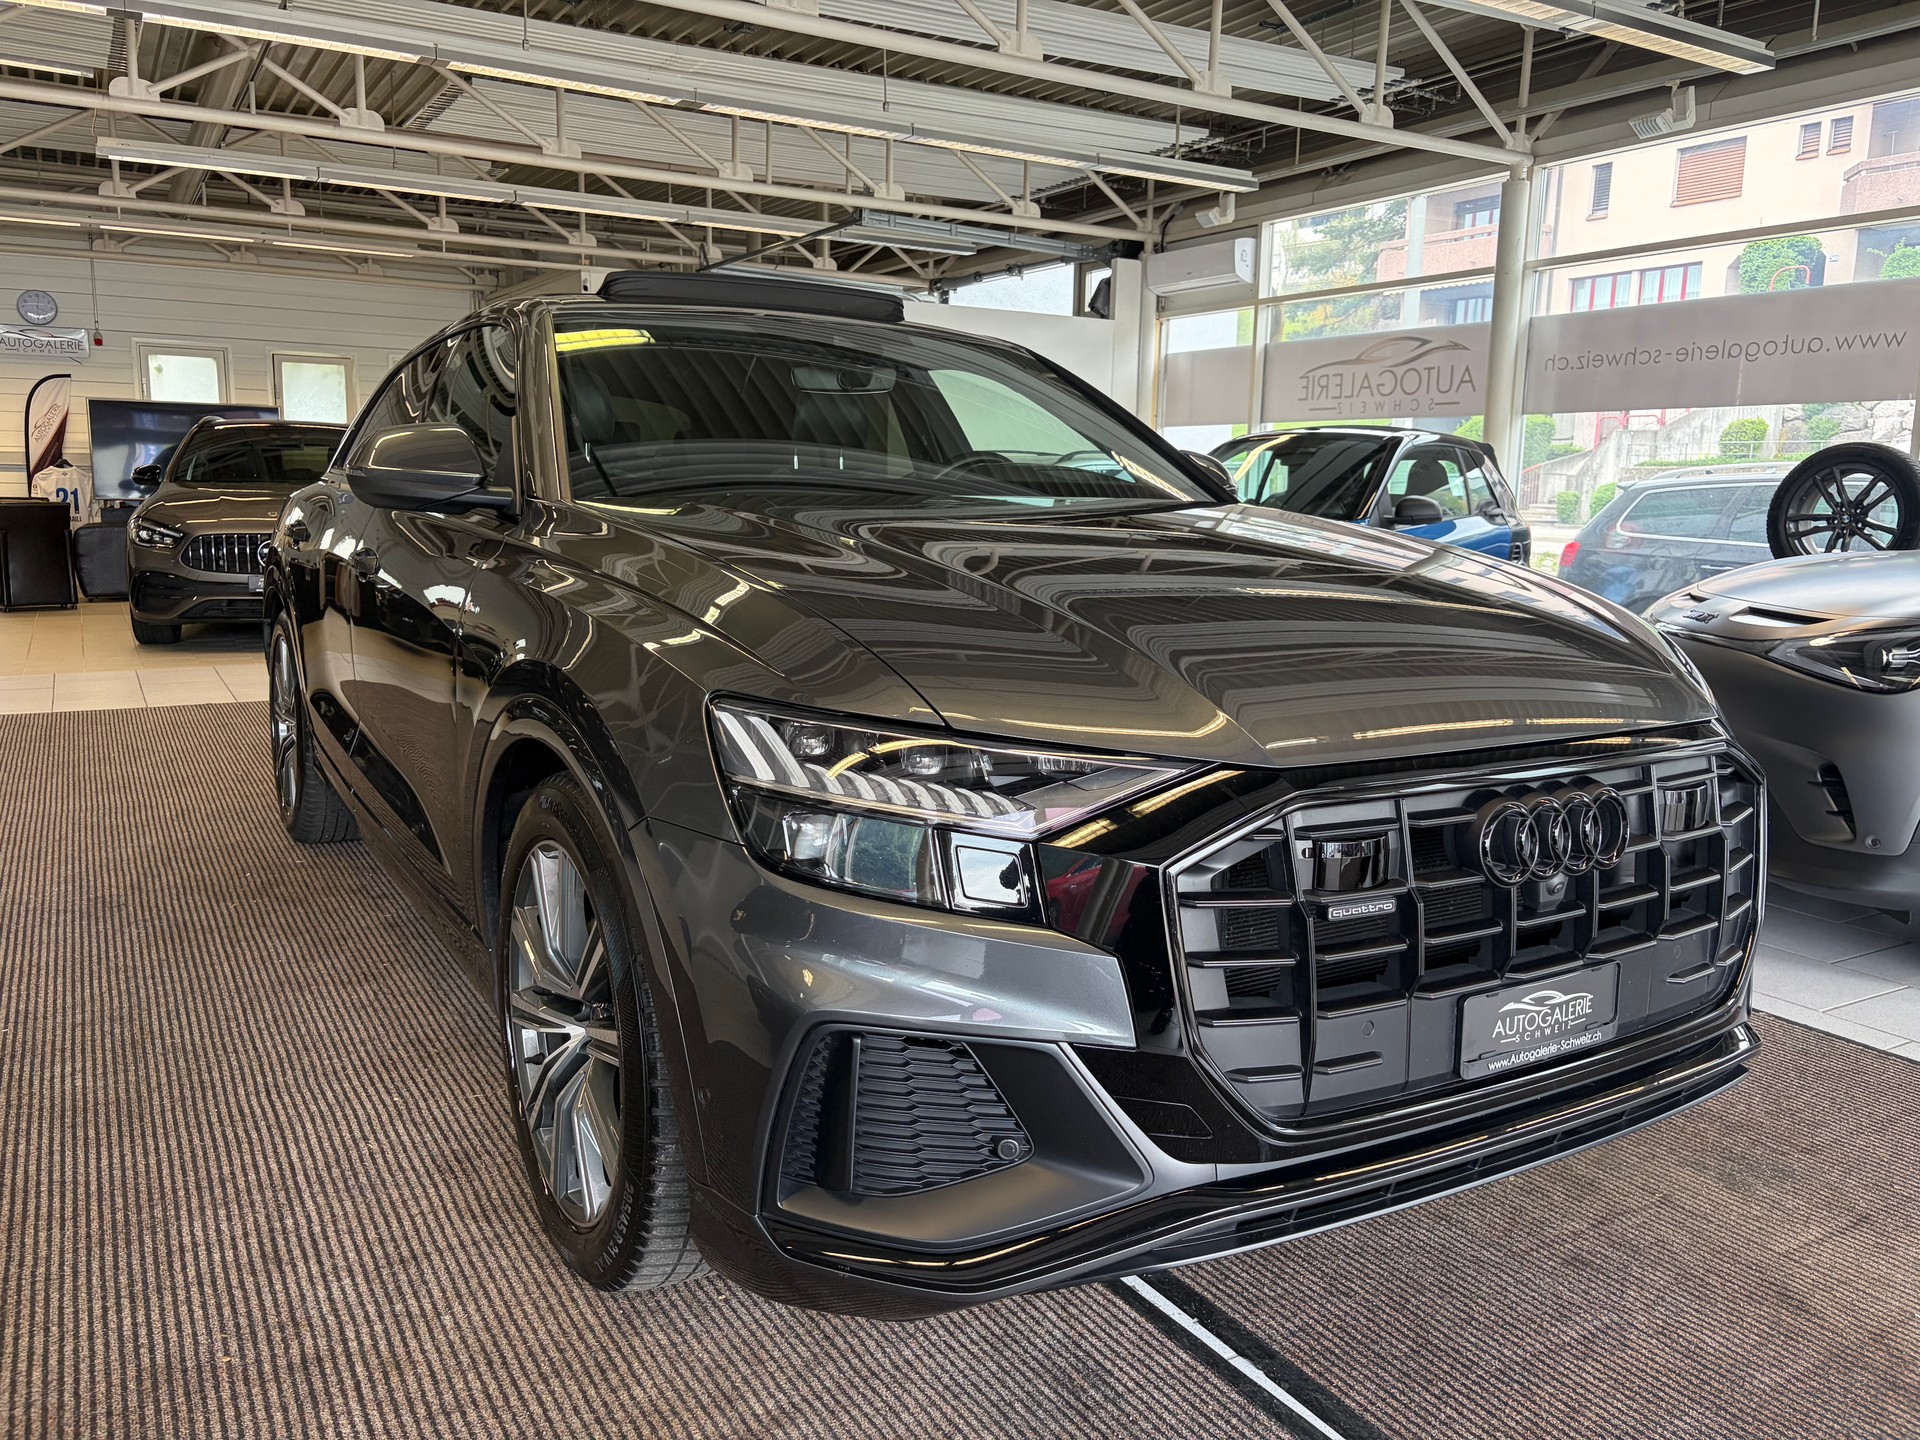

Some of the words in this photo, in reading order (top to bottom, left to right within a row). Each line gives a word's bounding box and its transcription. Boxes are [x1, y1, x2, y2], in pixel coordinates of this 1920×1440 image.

[0, 337, 84, 351] AUTOGALERIE
[34, 403, 62, 443] AUTOGALERIE
[1332, 903, 1393, 918] quattro
[1492, 996, 1593, 1038] AUTOGALERIE
[1515, 1020, 1572, 1043] SCHWEIZ
[1487, 1031, 1602, 1071] www.Autogalerie-Schweiz.ch
